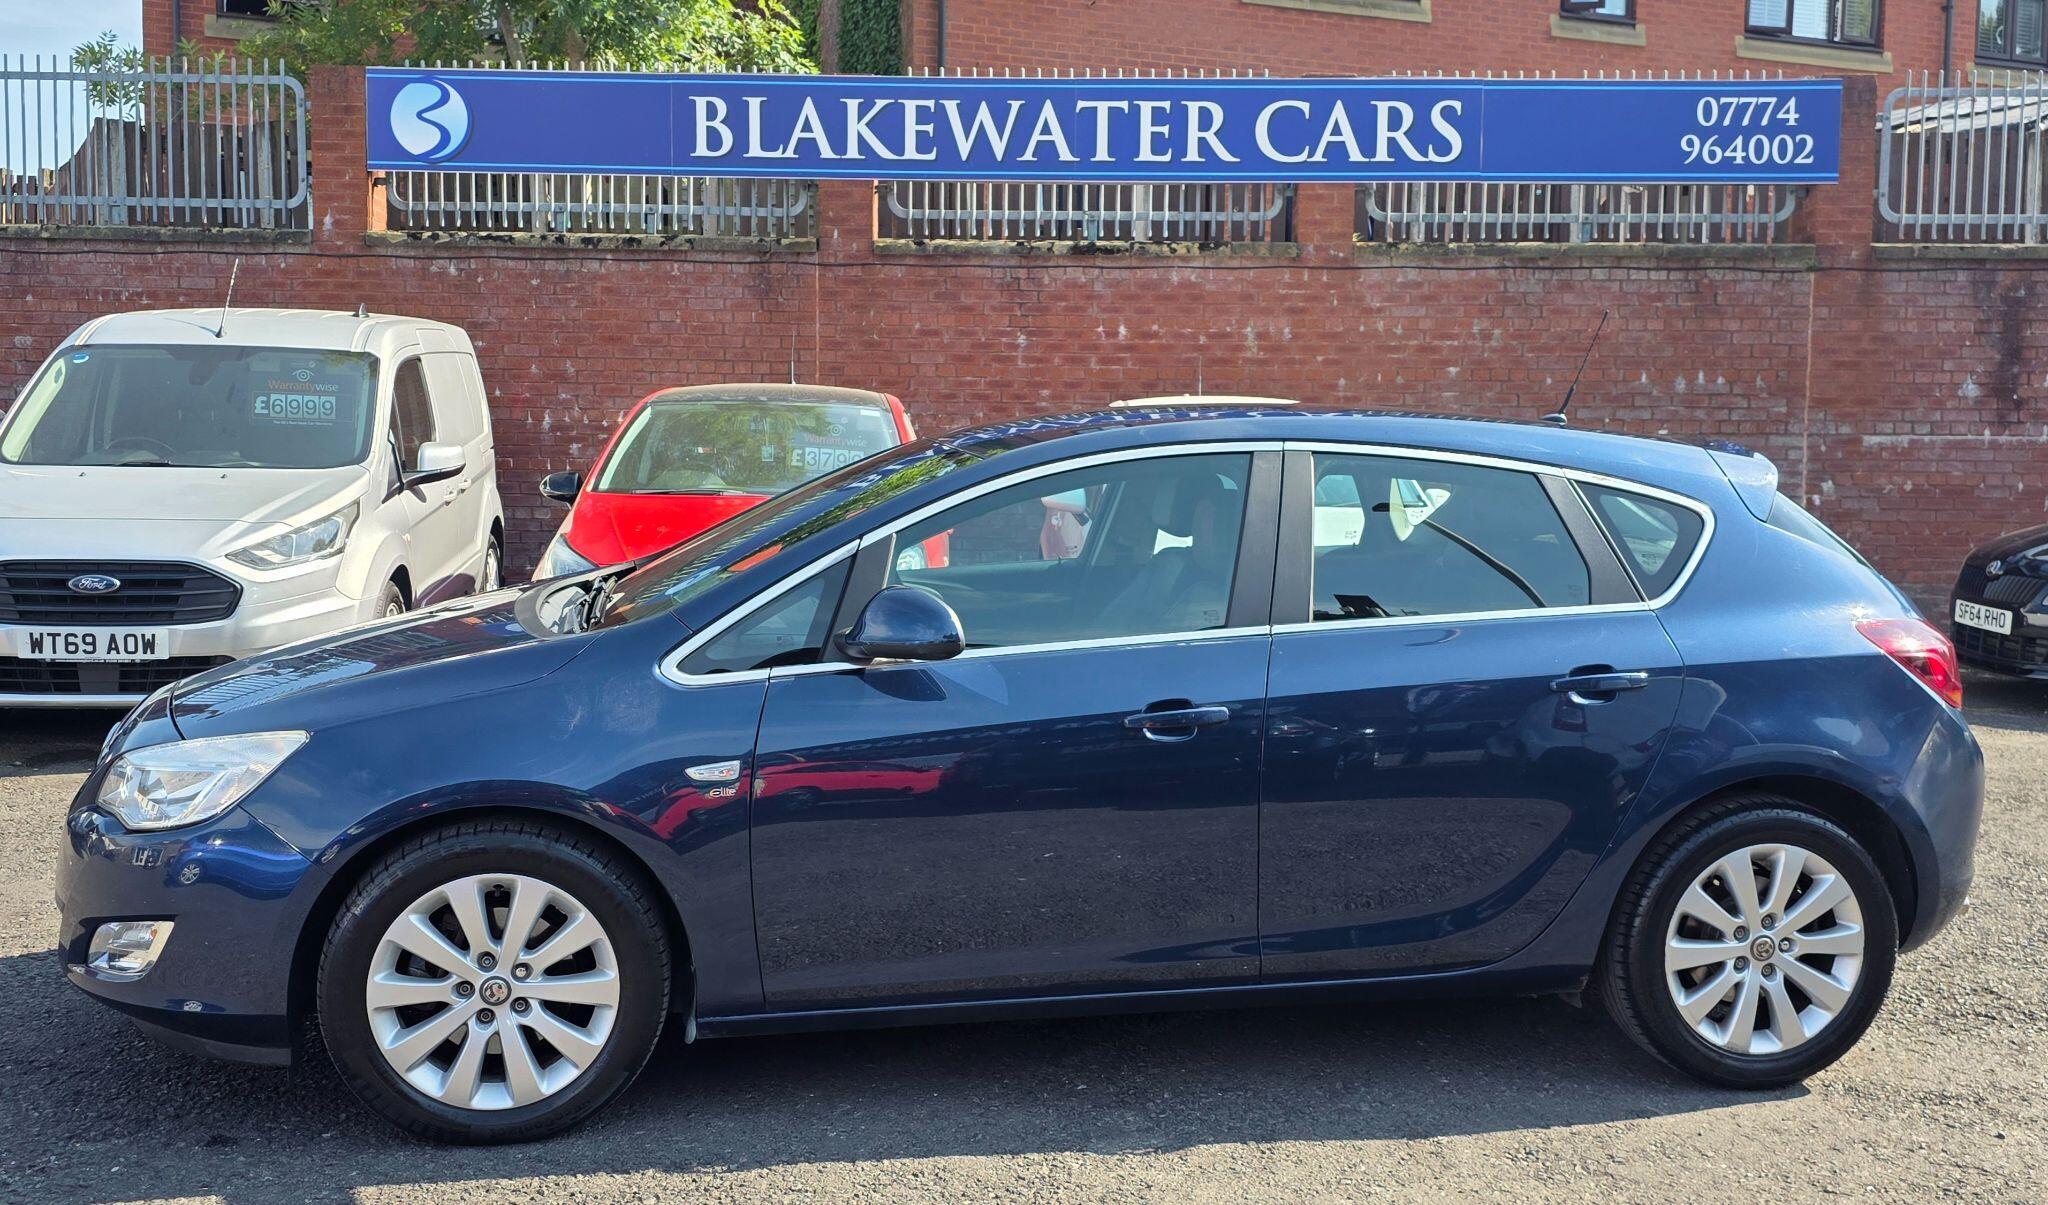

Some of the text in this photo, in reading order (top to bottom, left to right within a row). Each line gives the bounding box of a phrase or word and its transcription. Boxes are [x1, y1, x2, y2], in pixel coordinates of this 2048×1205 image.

[1696, 96, 1800, 127] 07774
[688, 96, 1463, 164] BLAKEWATER CARS
[1681, 133, 1815, 165] 964002
[254, 395, 335, 416] £6999
[78, 577, 107, 590] Ford
[1958, 602, 2006, 629] SF64 RHO
[29, 632, 156, 655] WT69 AOW
